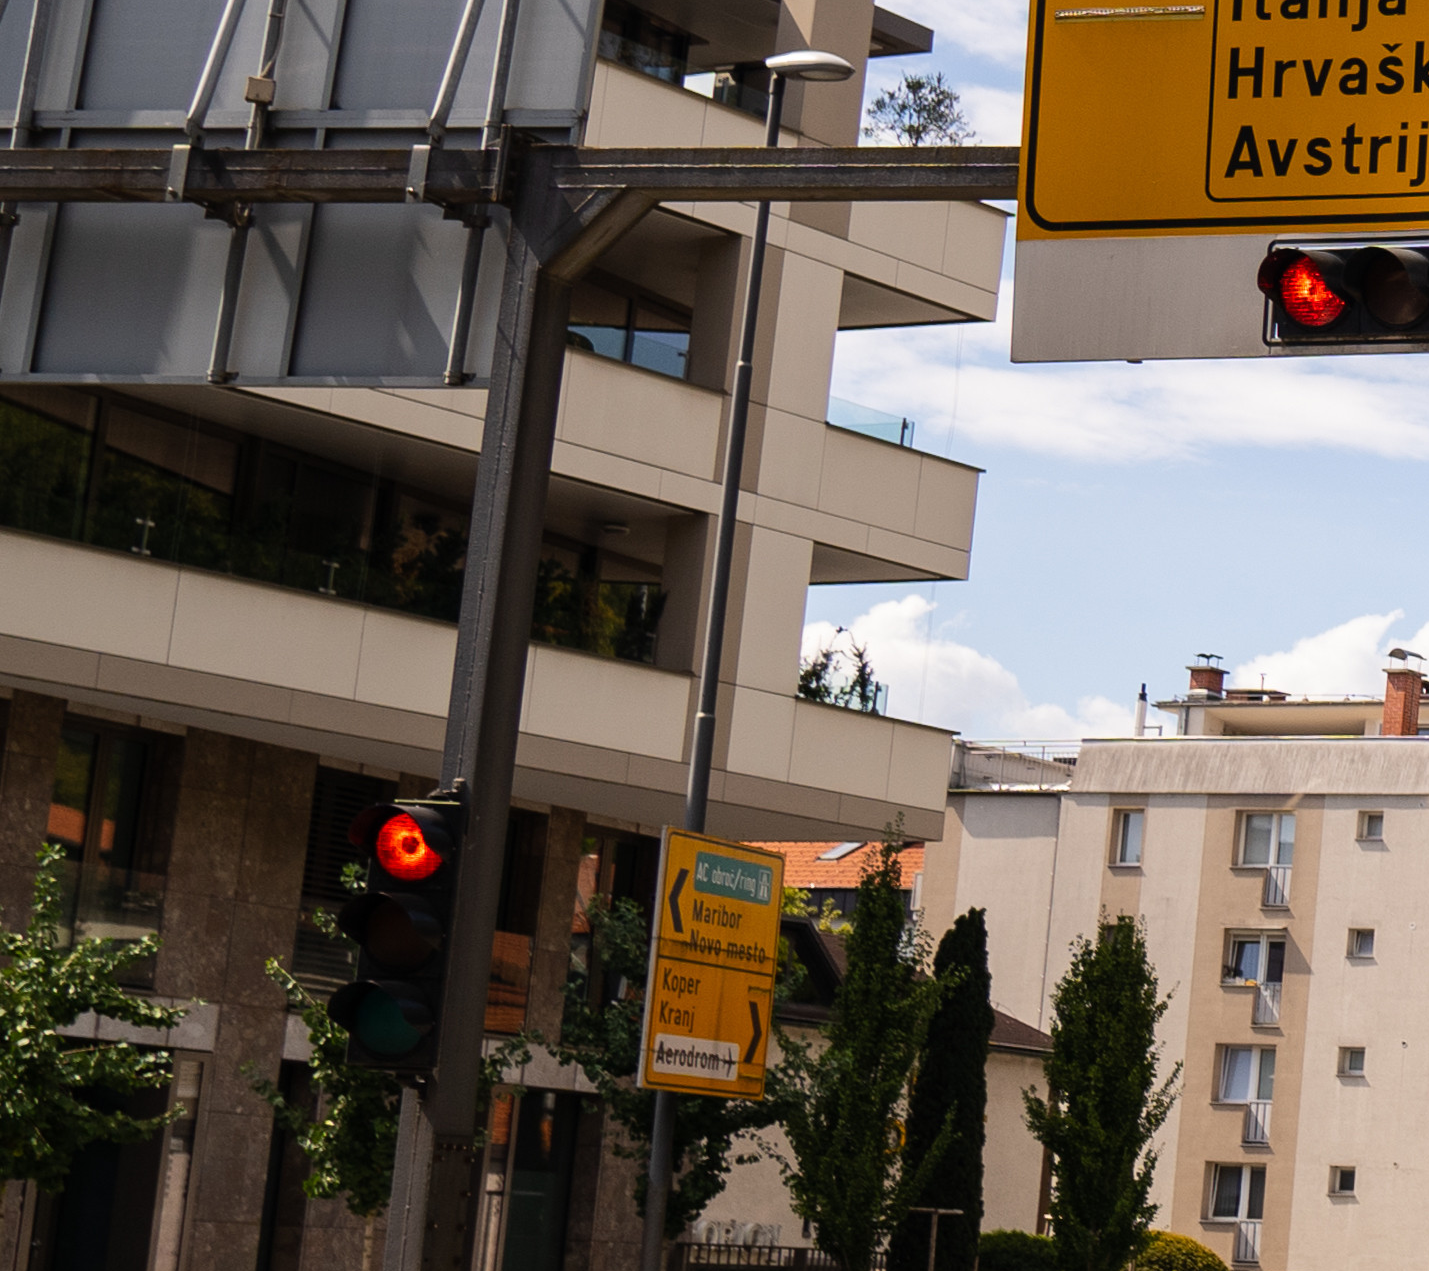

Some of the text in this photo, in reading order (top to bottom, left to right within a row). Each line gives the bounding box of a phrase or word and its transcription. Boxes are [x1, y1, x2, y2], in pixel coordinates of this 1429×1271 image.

[697, 861, 709, 882] AC
[692, 898, 742, 929] Maribor
[690, 929, 766, 964] Novo mesto
[663, 967, 701, 999] Koper
[659, 1000, 696, 1033] Kranj
[655, 1041, 719, 1070] Aerodrom
